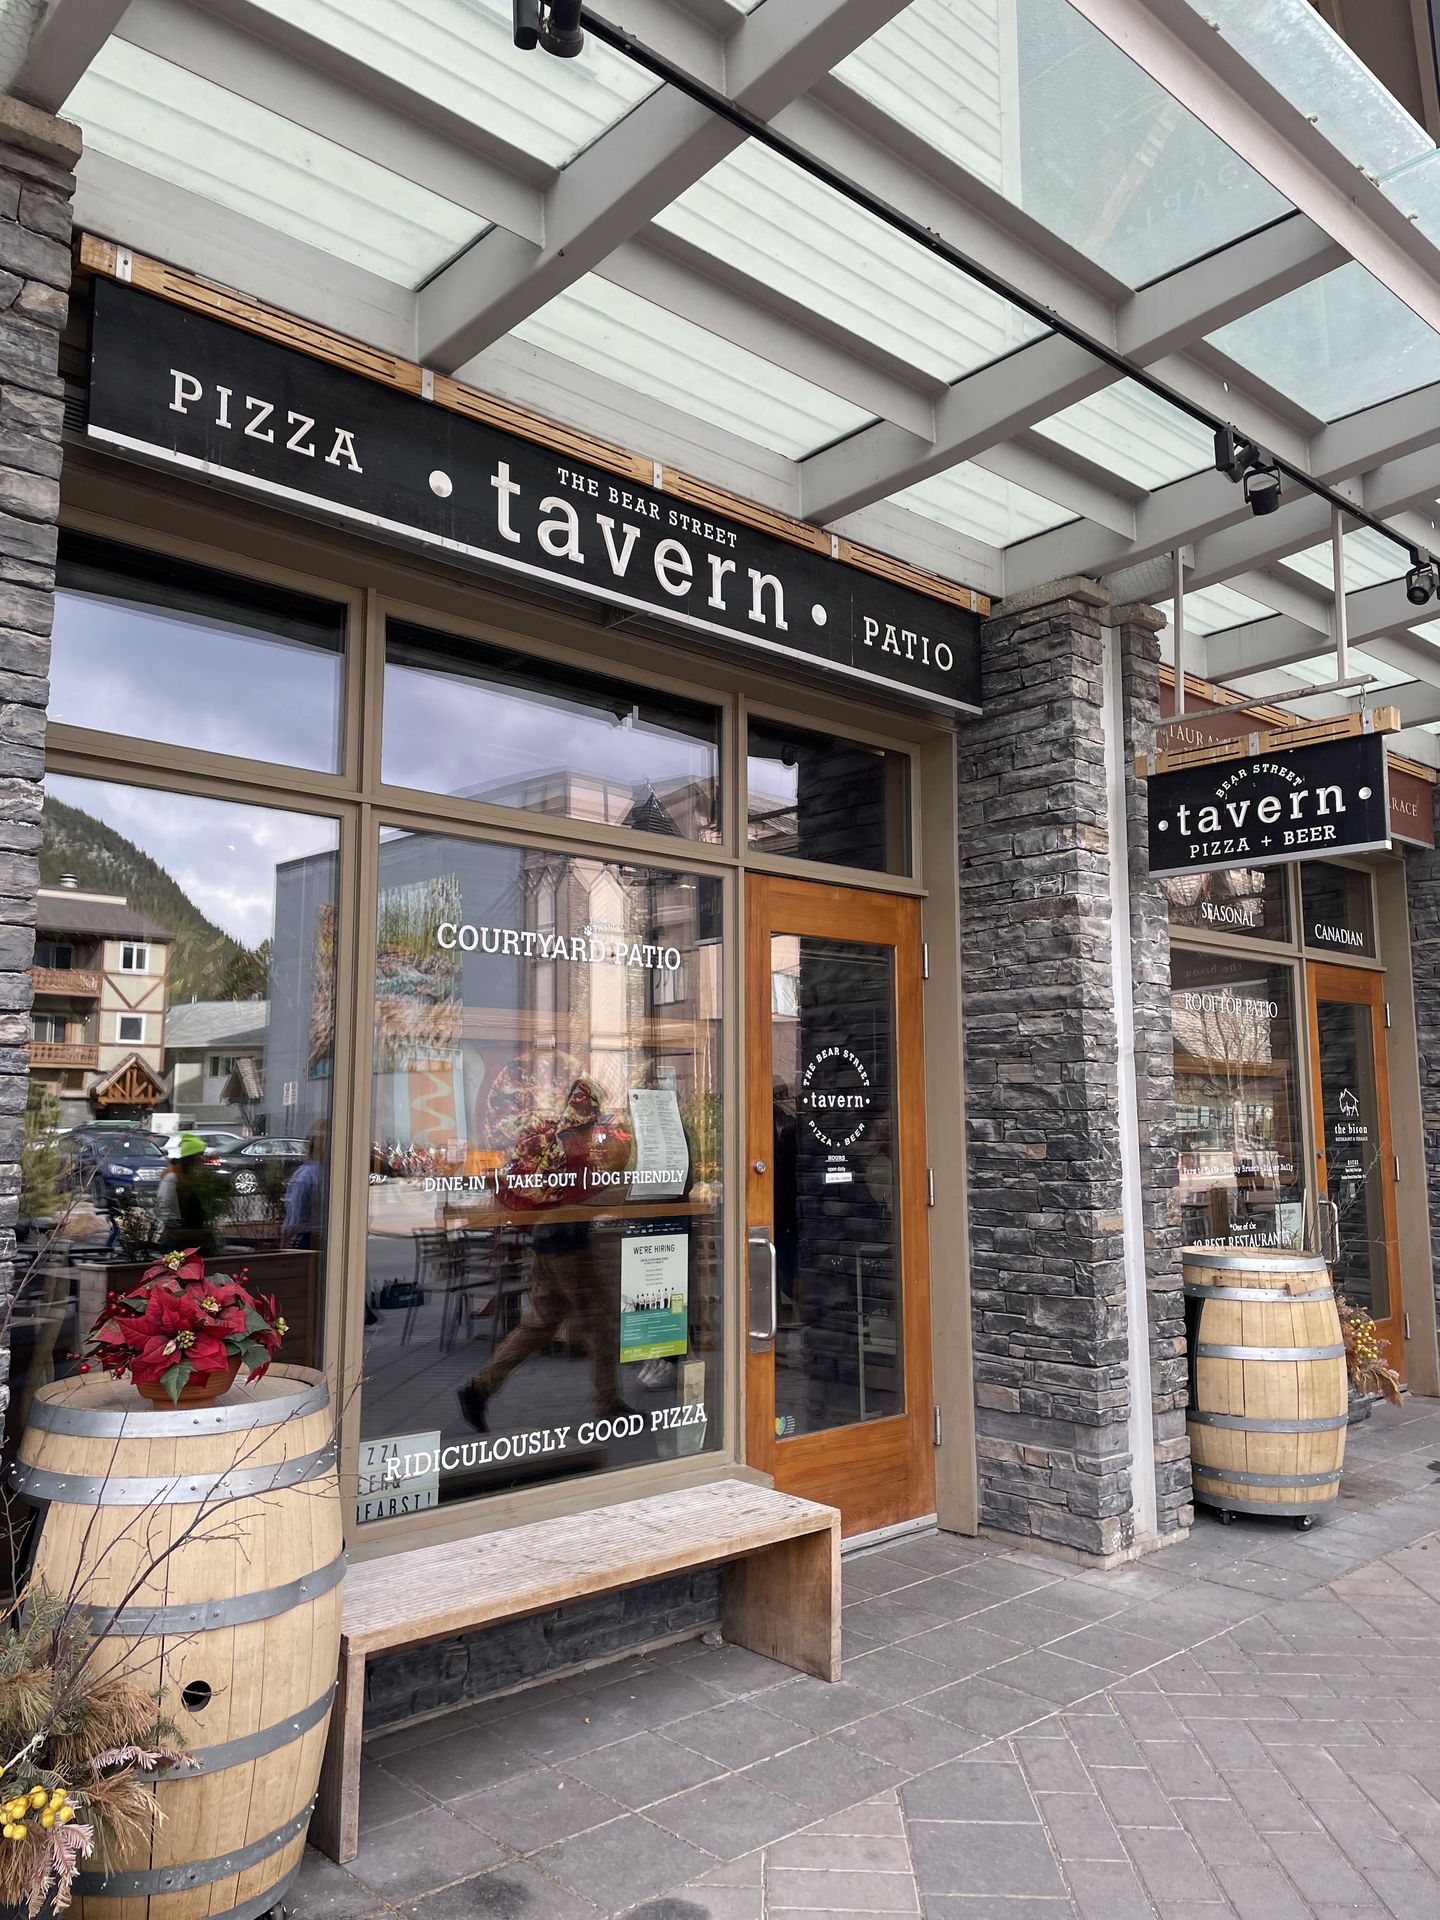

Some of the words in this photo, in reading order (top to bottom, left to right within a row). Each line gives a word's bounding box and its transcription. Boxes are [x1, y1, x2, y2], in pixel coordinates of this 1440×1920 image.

[169, 368, 363, 474] PIZZA
[557, 467, 599, 498] THE
[608, 485, 661, 521] BEAR
[668, 510, 737, 548] STREET
[490, 460, 789, 632] tavern
[863, 615, 953, 672] PATIO
[1215, 768, 1248, 798] BEAR
[1252, 763, 1303, 787] STREET
[1176, 785, 1346, 836] tavern
[1389, 797, 1418, 816] RACE
[1189, 837, 1251, 858] PIZZA
[1283, 824, 1337, 846] BEER
[1201, 901, 1256, 927] SEASONAL
[437, 921, 606, 964] COURTYARD
[613, 941, 682, 971] PATIO
[1314, 923, 1364, 947] CANADIAN
[1184, 992, 1243, 1014] ROOFTOP
[1245, 998, 1278, 1018] PATIO
[803, 1062, 816, 1087] THE
[815, 1046, 840, 1063] BEAR
[842, 1049, 870, 1087] STREET
[810, 1091, 864, 1108] tavern
[808, 1119, 832, 1147] PIZZA
[844, 1122, 866, 1146] BEER
[1334, 1123, 1346, 1134] the
[1348, 1123, 1368, 1134] bison
[423, 1175, 487, 1194] DINE-IN
[506, 1172, 577, 1189] TAKE-OUT
[591, 1171, 621, 1186] DOG
[623, 1169, 684, 1185] FRIENDLY
[633, 1245, 652, 1255] WE'RE
[654, 1243, 675, 1253] HIRING
[384, 1426, 571, 1481] RIDICULOUSLY
[577, 1414, 644, 1445] GOOD
[650, 1402, 708, 1432] PIZZA
